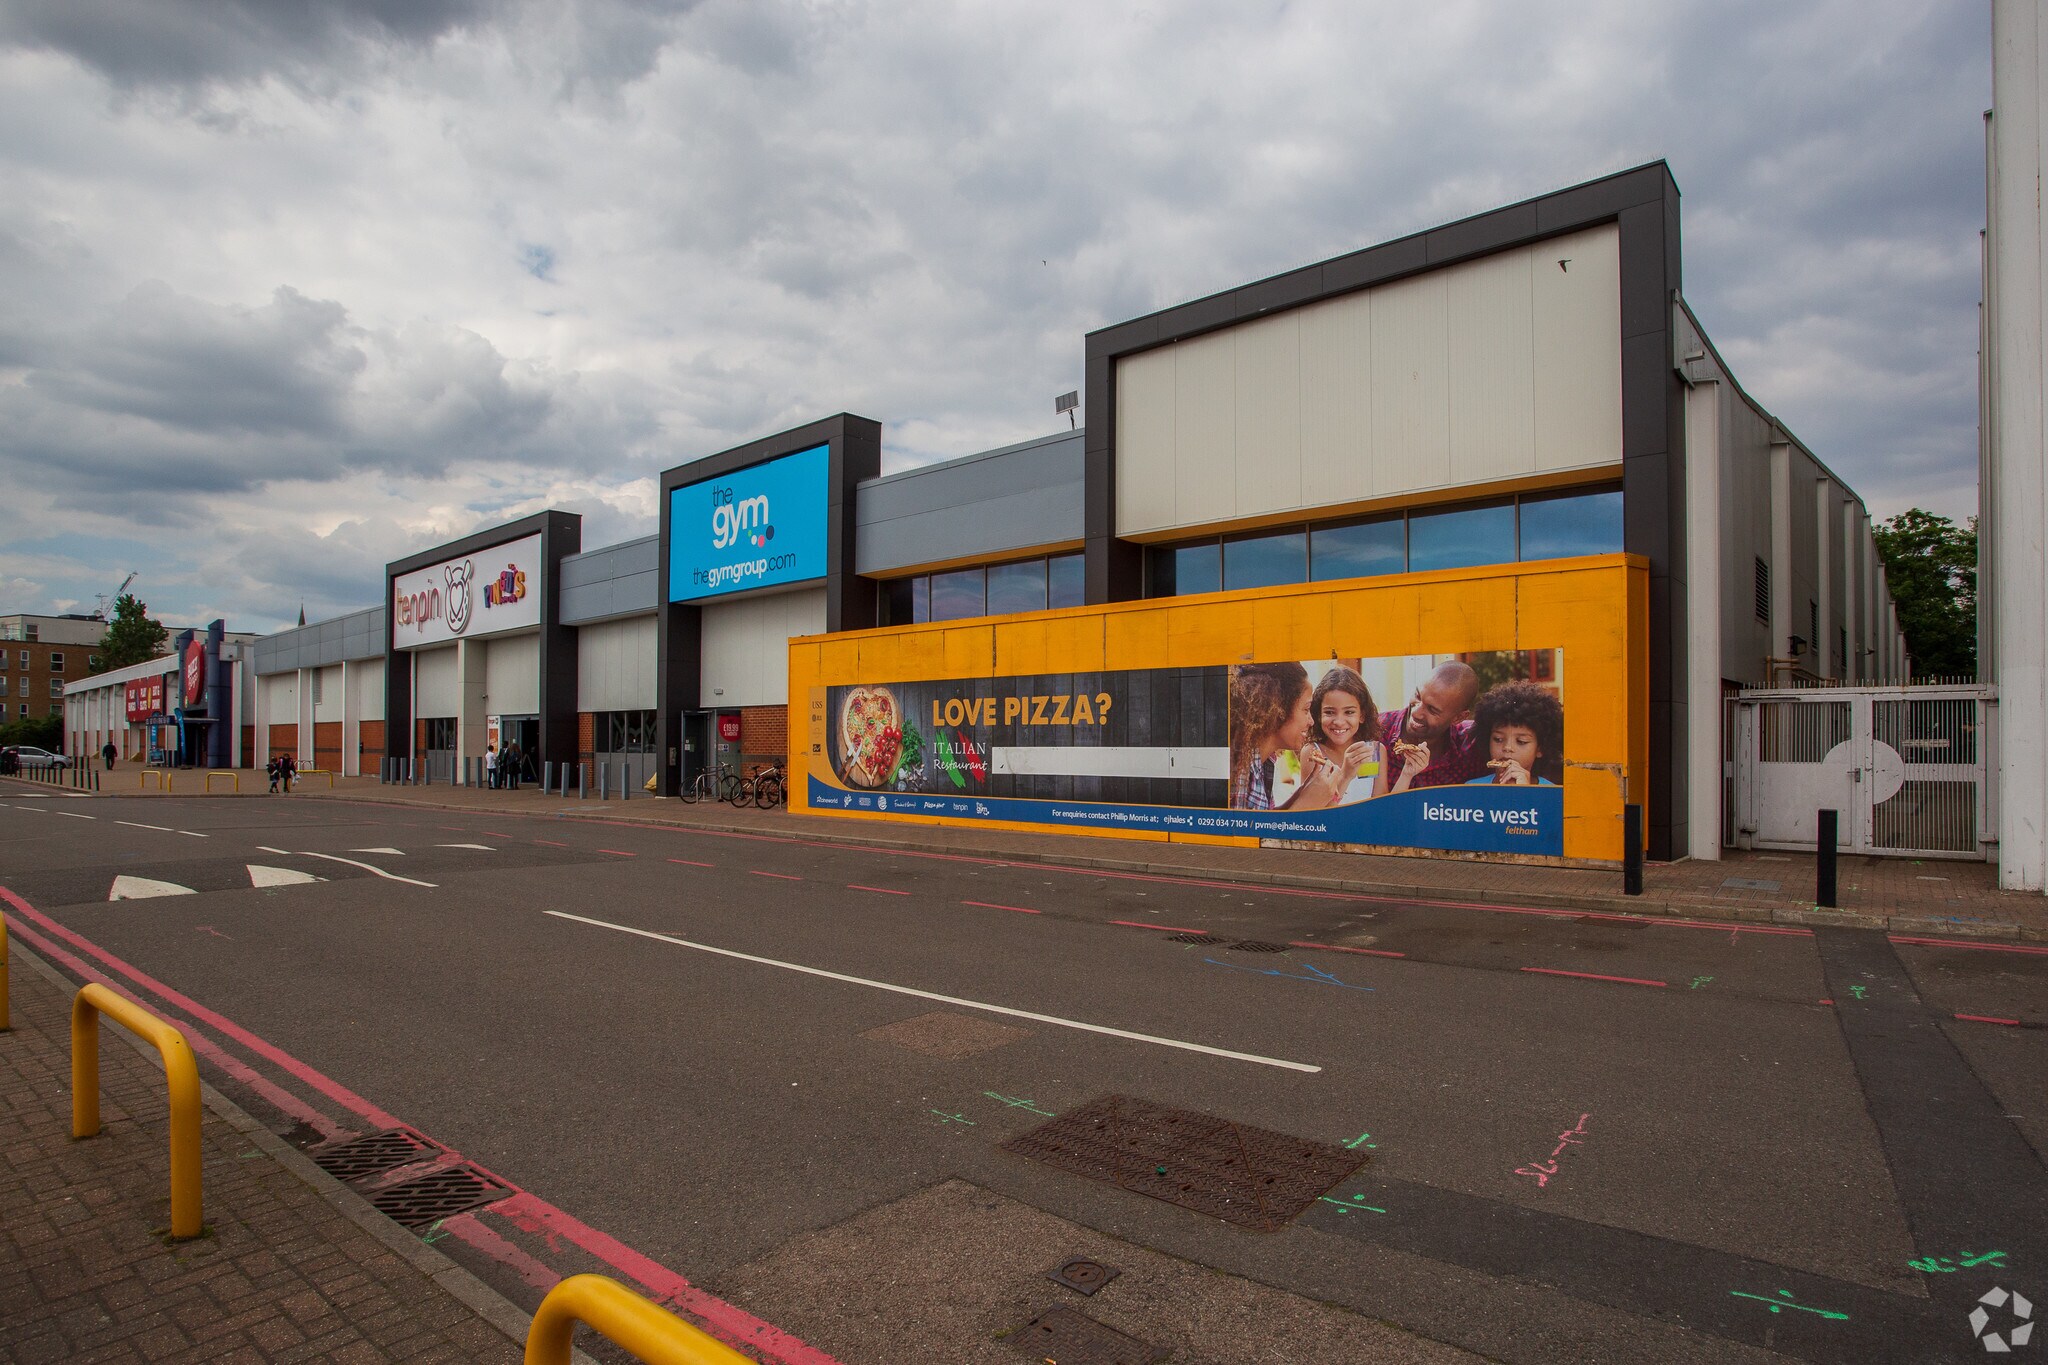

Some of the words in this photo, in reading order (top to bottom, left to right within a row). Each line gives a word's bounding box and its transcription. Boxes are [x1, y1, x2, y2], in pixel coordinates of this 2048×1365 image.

[713, 486, 733, 507] the
[713, 494, 769, 549] gym
[693, 553, 796, 588] thegymgroup.com
[396, 579, 441, 633] tenpin
[932, 697, 997, 727] LOVE
[1004, 692, 1113, 726] PIZZA?
[933, 742, 986, 755] ITALIAN
[933, 759, 988, 771] Restaurant
[953, 802, 969, 812] tenpin
[1423, 802, 1485, 823] leisure
[1489, 808, 1538, 825] west
[1052, 809, 1061, 817] For
[1062, 810, 1088, 820] enquiries
[1088, 812, 1110, 820] contact
[1110, 812, 1128, 822] Phillip
[1128, 813, 1149, 822] Morris
[1163, 815, 1186, 824] ejhales
[1197, 817, 1215, 826] 0292
[1215, 818, 1230, 827] 034
[1230, 819, 1248, 828] 7104
[1254, 821, 1327, 833] pvm@ejhales.co.uk
[1505, 825, 1538, 836] feltham
